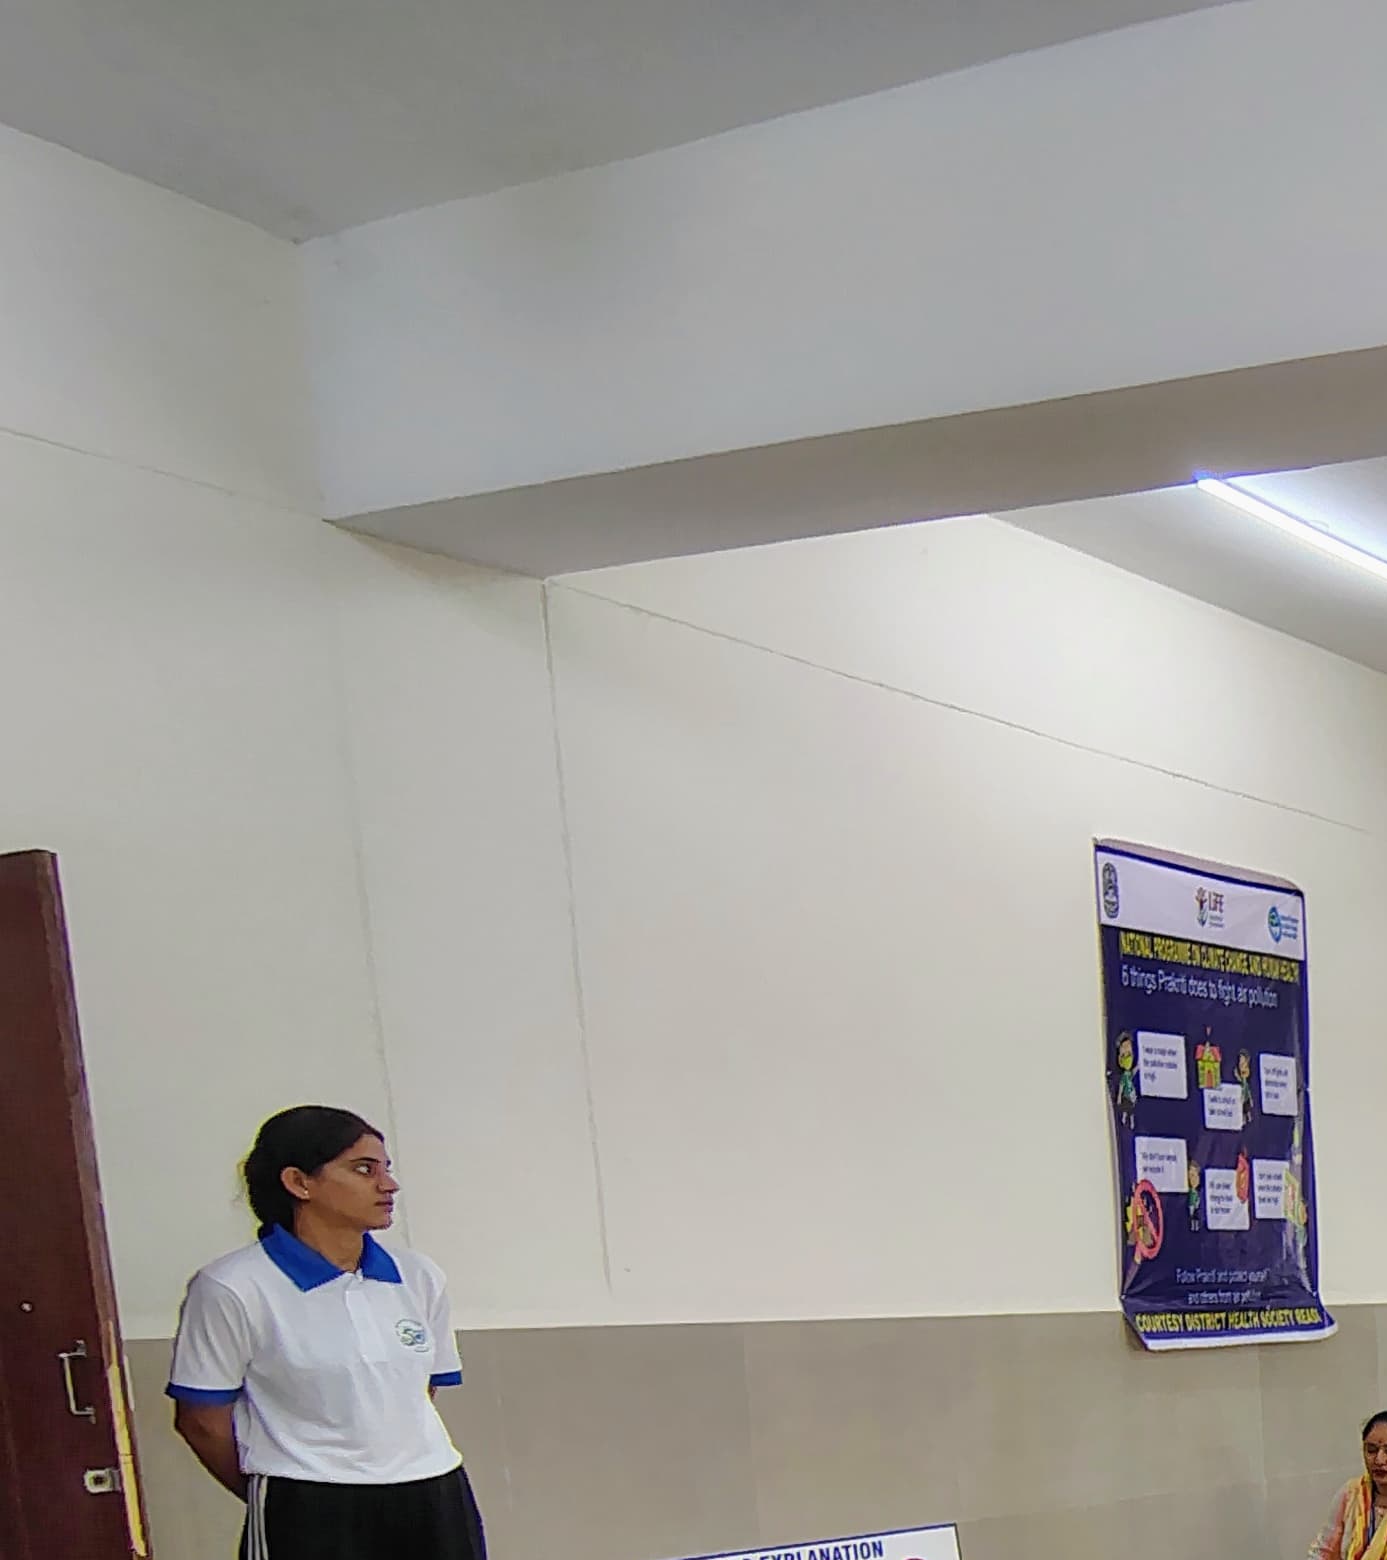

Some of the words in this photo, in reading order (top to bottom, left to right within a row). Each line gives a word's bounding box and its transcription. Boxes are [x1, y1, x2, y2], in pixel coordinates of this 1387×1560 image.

[1130, 966, 1157, 994] things
[1135, 1312, 1183, 1333] COURTESY
[1184, 1311, 1226, 1331] DISTRICT
[1228, 1311, 1260, 1329] HEALTH
[1260, 1308, 1295, 1328] SOCIETY
